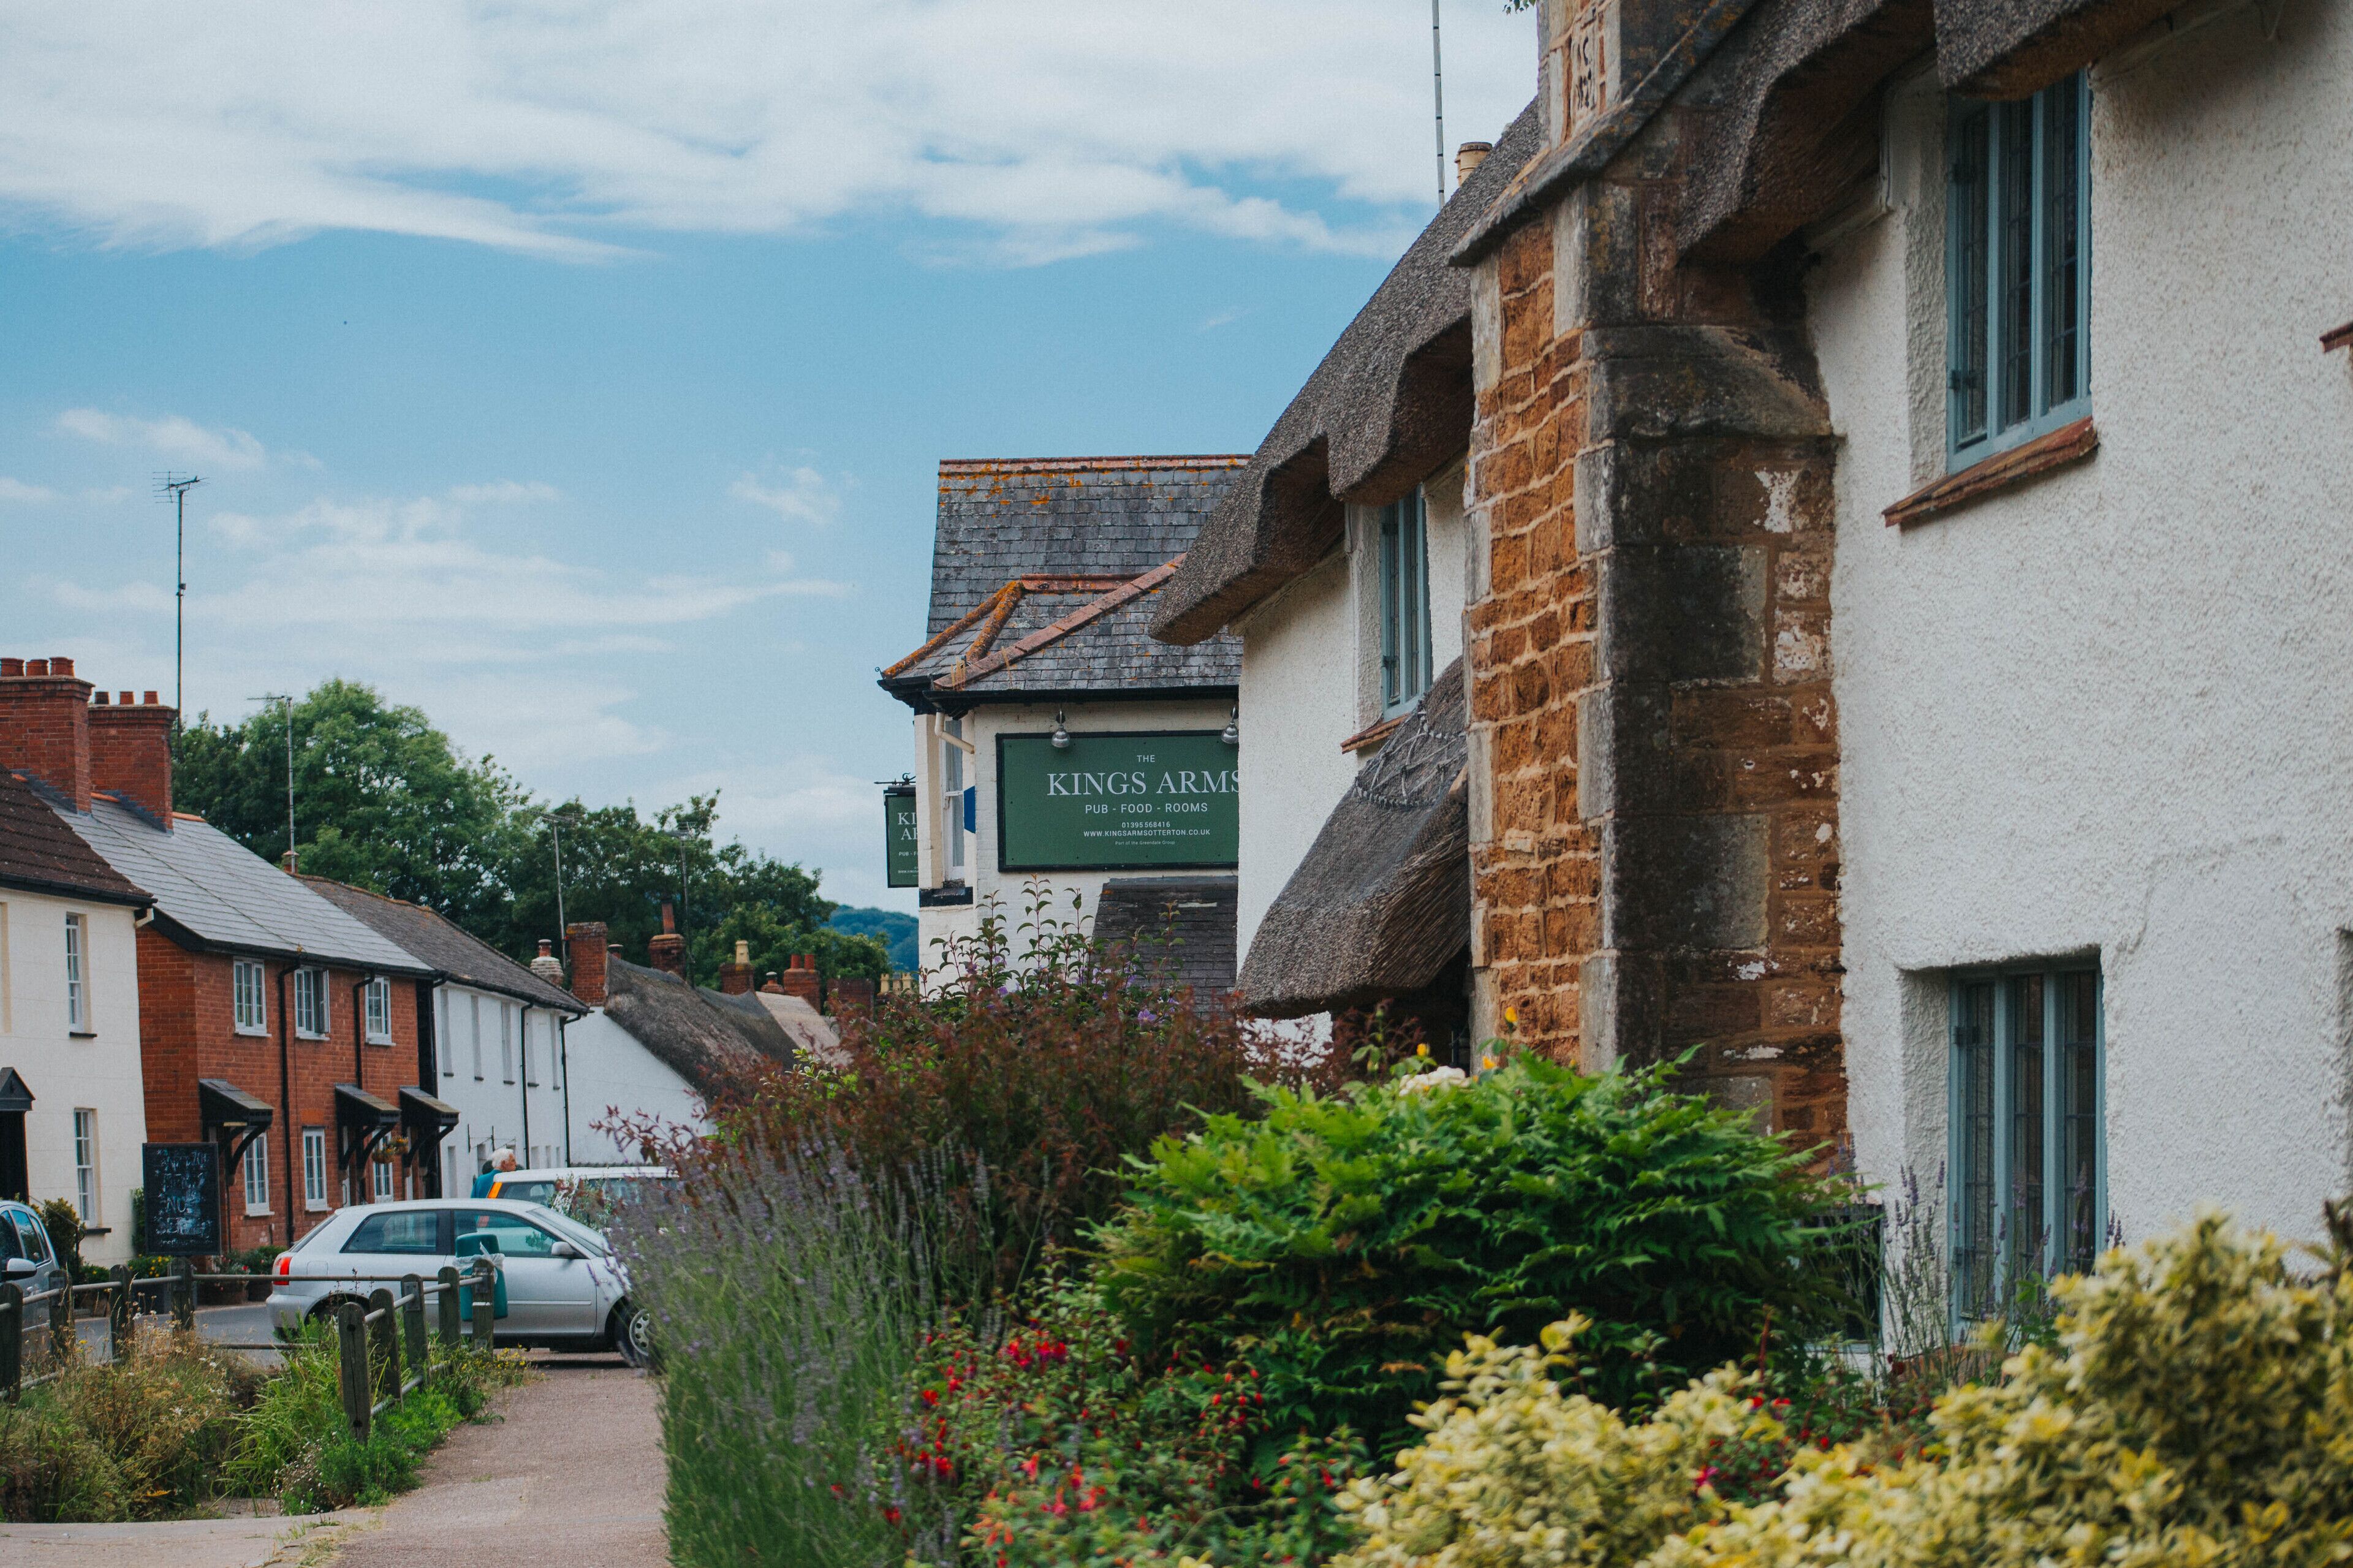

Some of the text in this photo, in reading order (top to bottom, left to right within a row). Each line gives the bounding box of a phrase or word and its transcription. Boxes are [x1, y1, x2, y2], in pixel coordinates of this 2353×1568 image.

[1047, 770, 1239, 795] KINGS ARMS
[1085, 804, 1108, 814] PUB
[1121, 803, 1152, 813] FOOD
[1165, 802, 1208, 812] ROOMS
[1083, 828, 1210, 837] WWW.KINGSARMSOTTERTON.CO.UK
